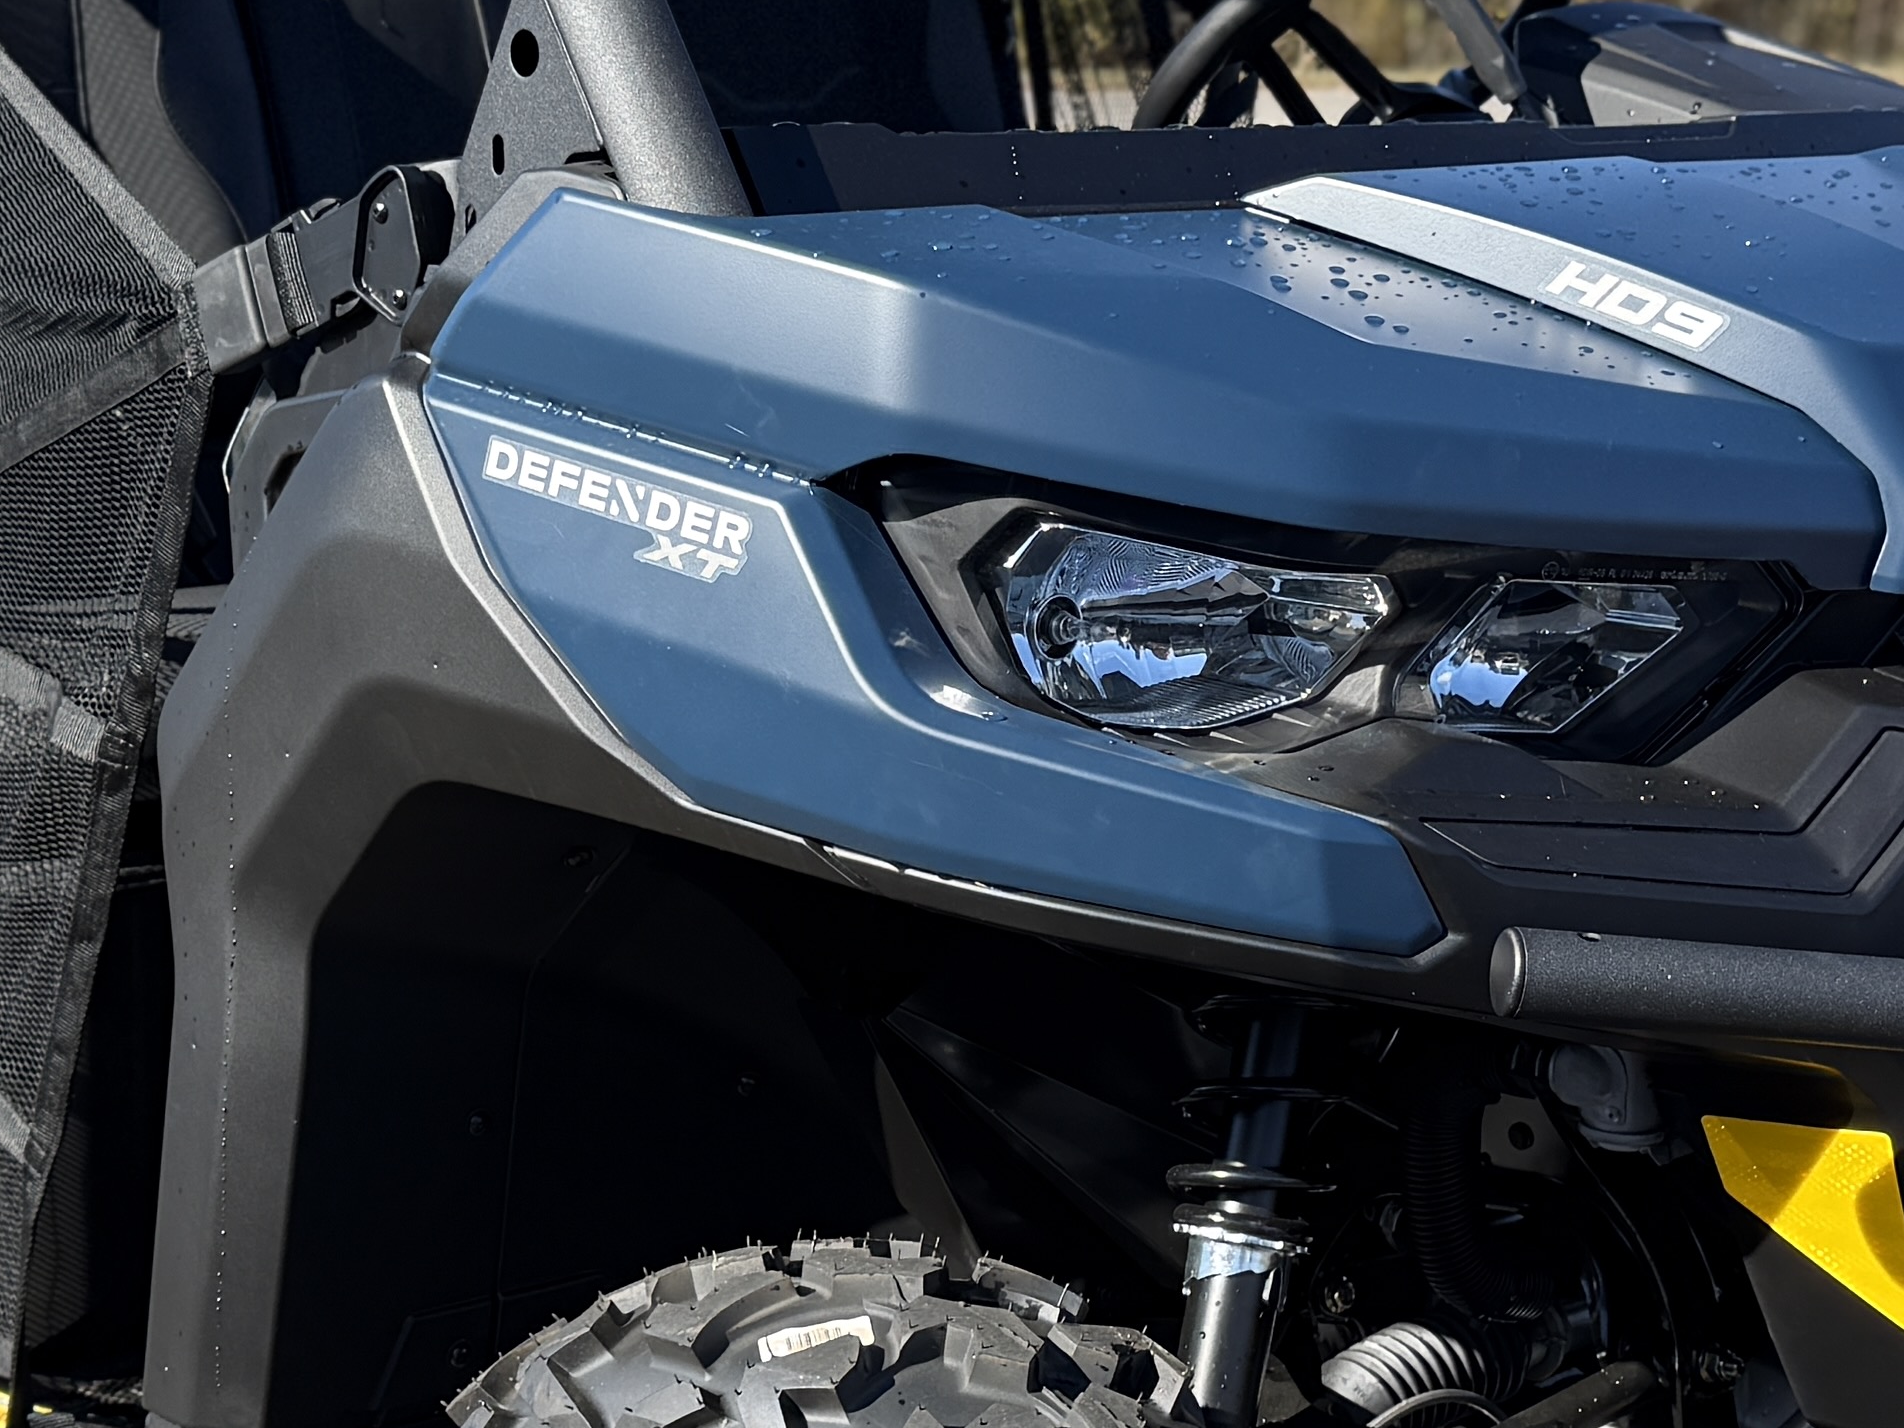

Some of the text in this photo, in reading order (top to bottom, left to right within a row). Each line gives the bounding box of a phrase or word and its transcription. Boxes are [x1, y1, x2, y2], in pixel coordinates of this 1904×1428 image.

[1545, 260, 1725, 349] HD9
[484, 437, 750, 556] DEFENDER
[643, 533, 740, 579] XT
